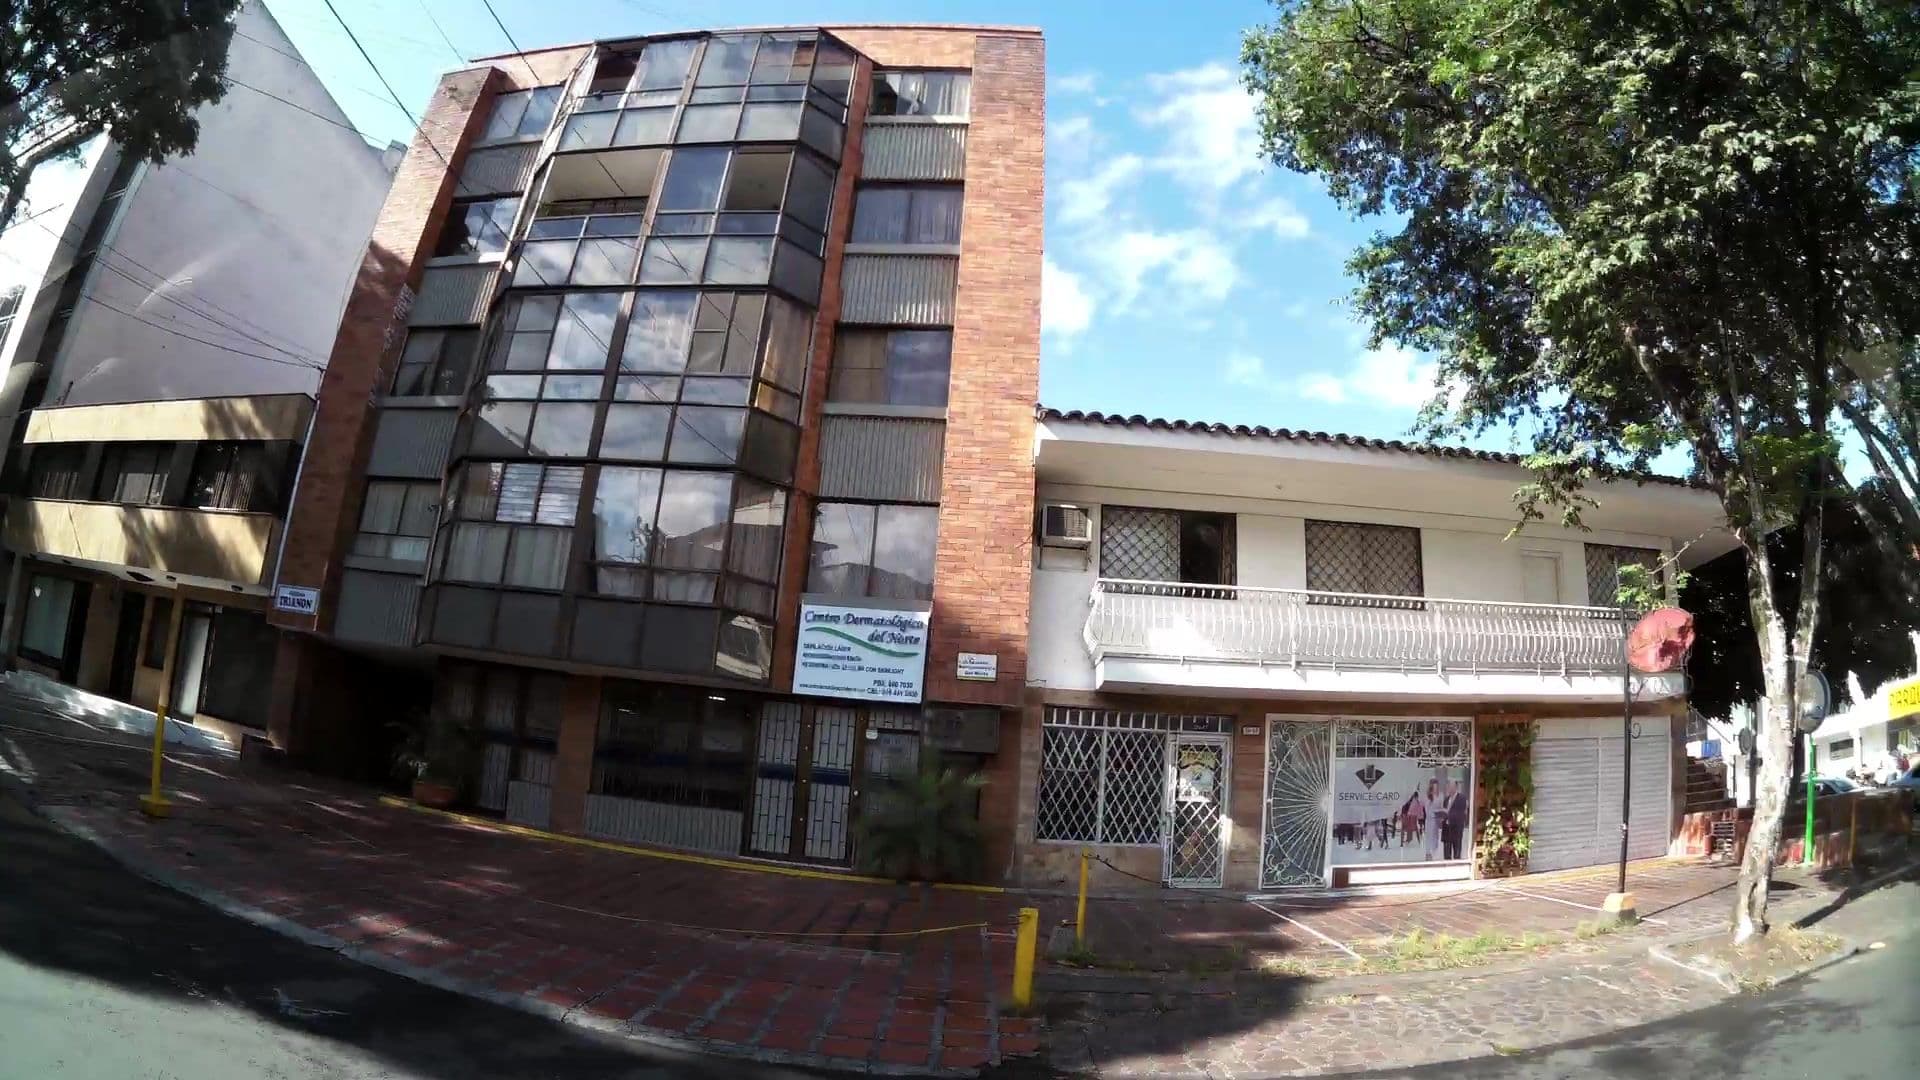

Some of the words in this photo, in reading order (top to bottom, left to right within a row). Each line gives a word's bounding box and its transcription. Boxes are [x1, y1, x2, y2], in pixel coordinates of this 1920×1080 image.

[280, 596, 313, 609] TRIANON
[805, 610, 841, 624] Centro
[868, 629, 888, 643] del
[886, 631, 921, 645] Norte
[1339, 791, 1374, 801] SERVICE
[1376, 791, 1401, 801] CARD
